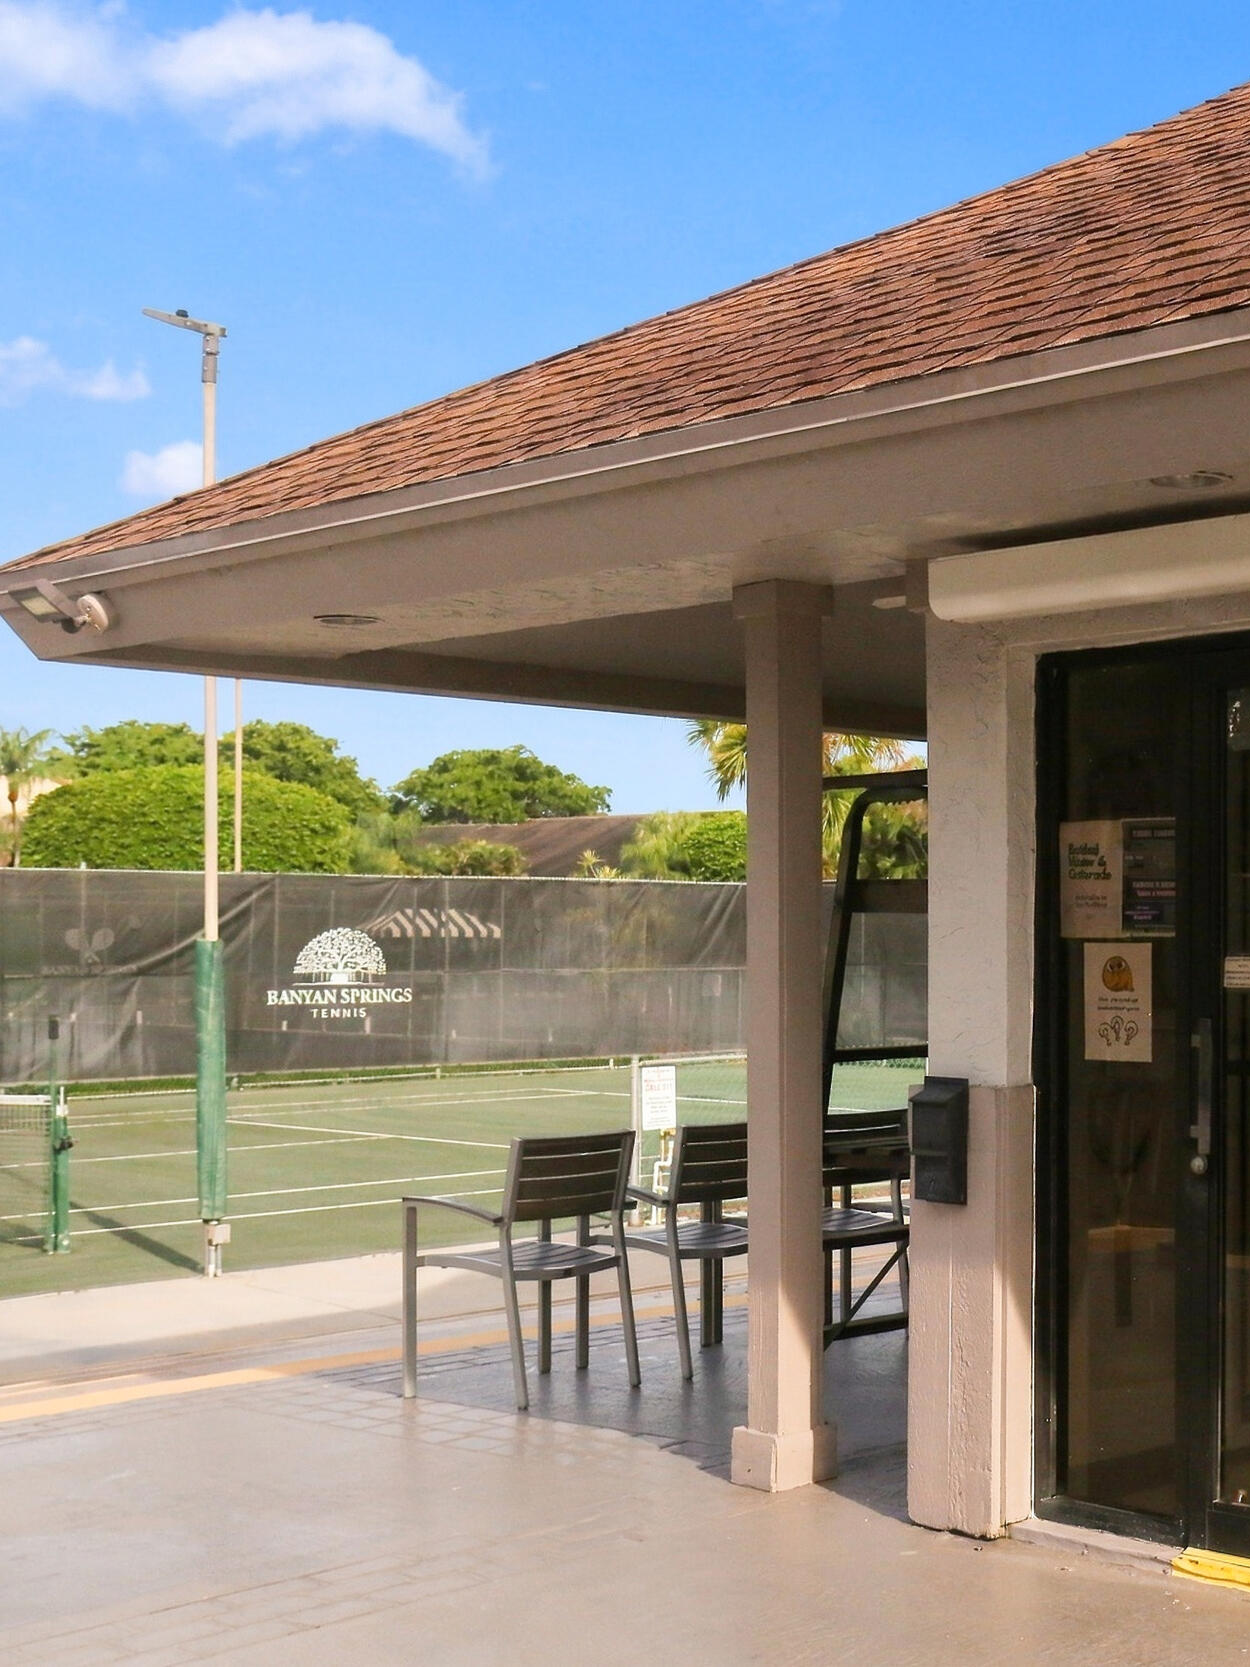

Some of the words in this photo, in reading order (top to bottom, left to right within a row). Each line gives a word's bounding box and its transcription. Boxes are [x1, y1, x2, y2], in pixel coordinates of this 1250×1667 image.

[266, 988, 337, 1006] BANYAN
[340, 987, 413, 1004] SPRINGS
[311, 1007, 367, 1019] TENNIS
